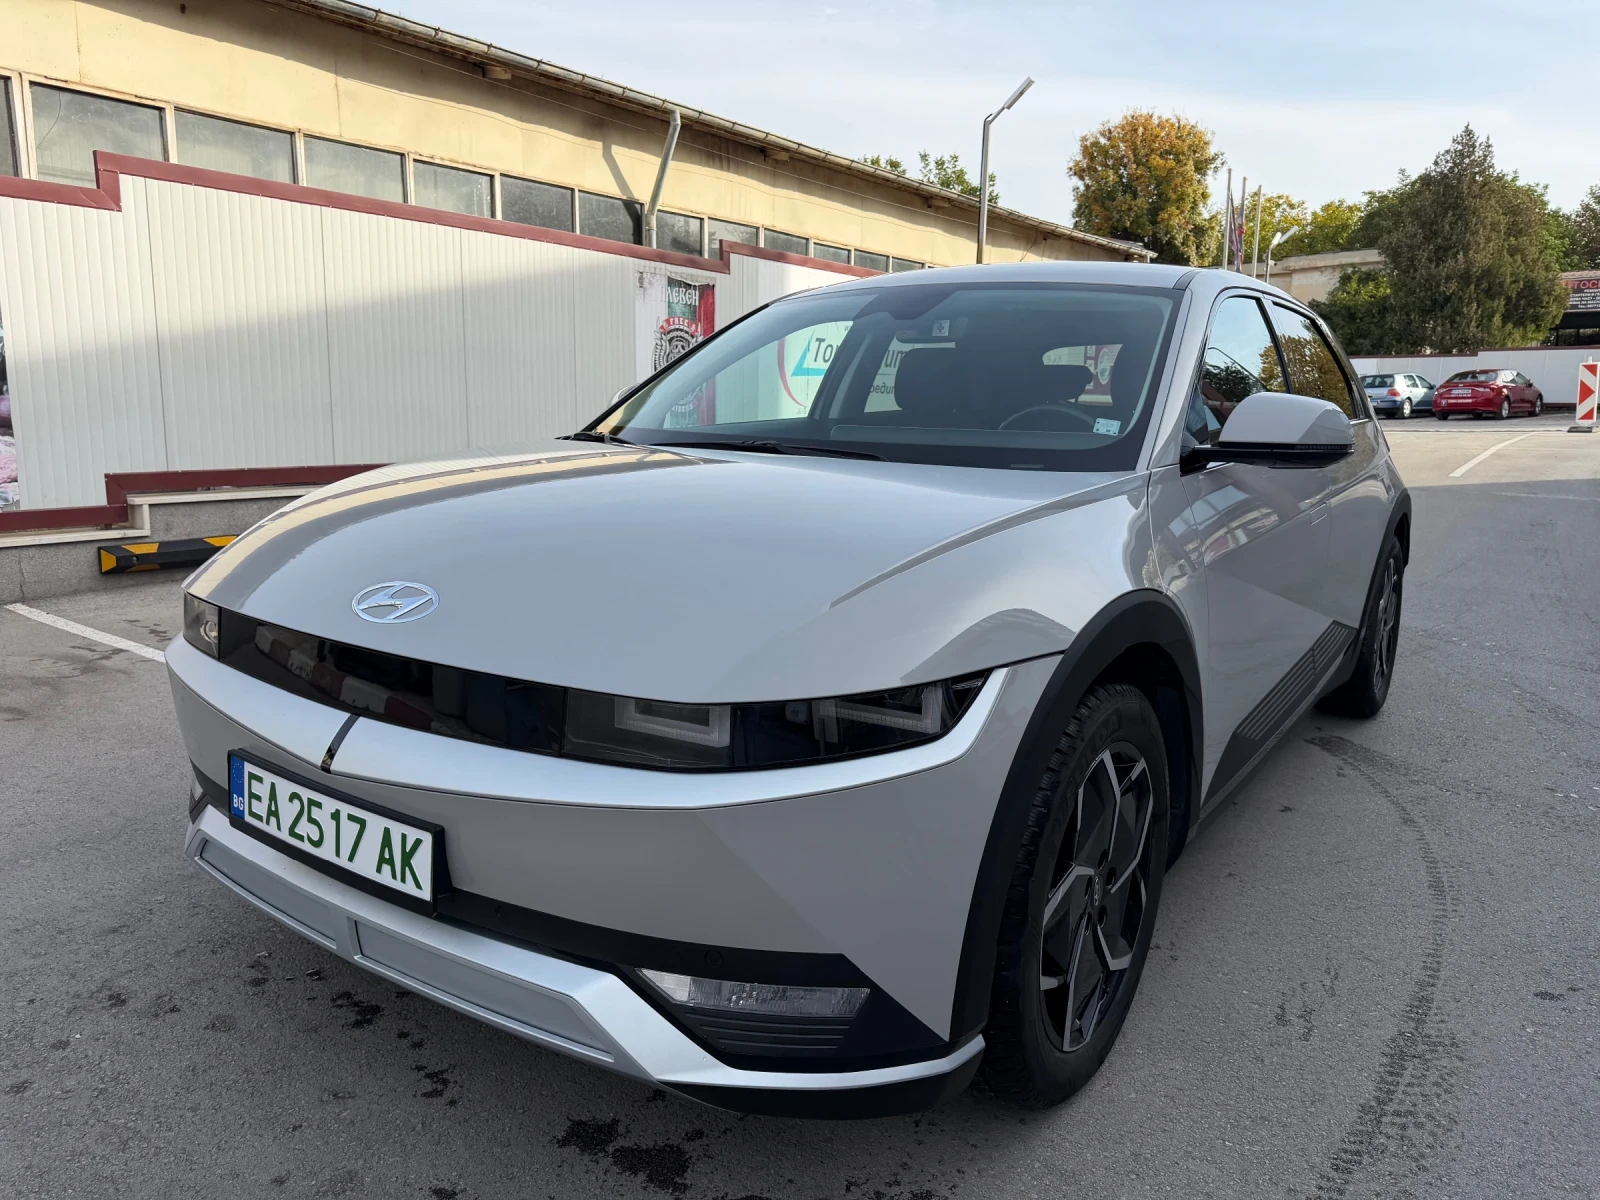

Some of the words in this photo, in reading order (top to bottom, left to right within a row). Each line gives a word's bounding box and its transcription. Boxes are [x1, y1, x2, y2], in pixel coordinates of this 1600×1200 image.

[233, 793, 244, 811] BG
[247, 770, 282, 832] EA
[288, 791, 367, 863] 2517
[375, 826, 424, 891] AK
